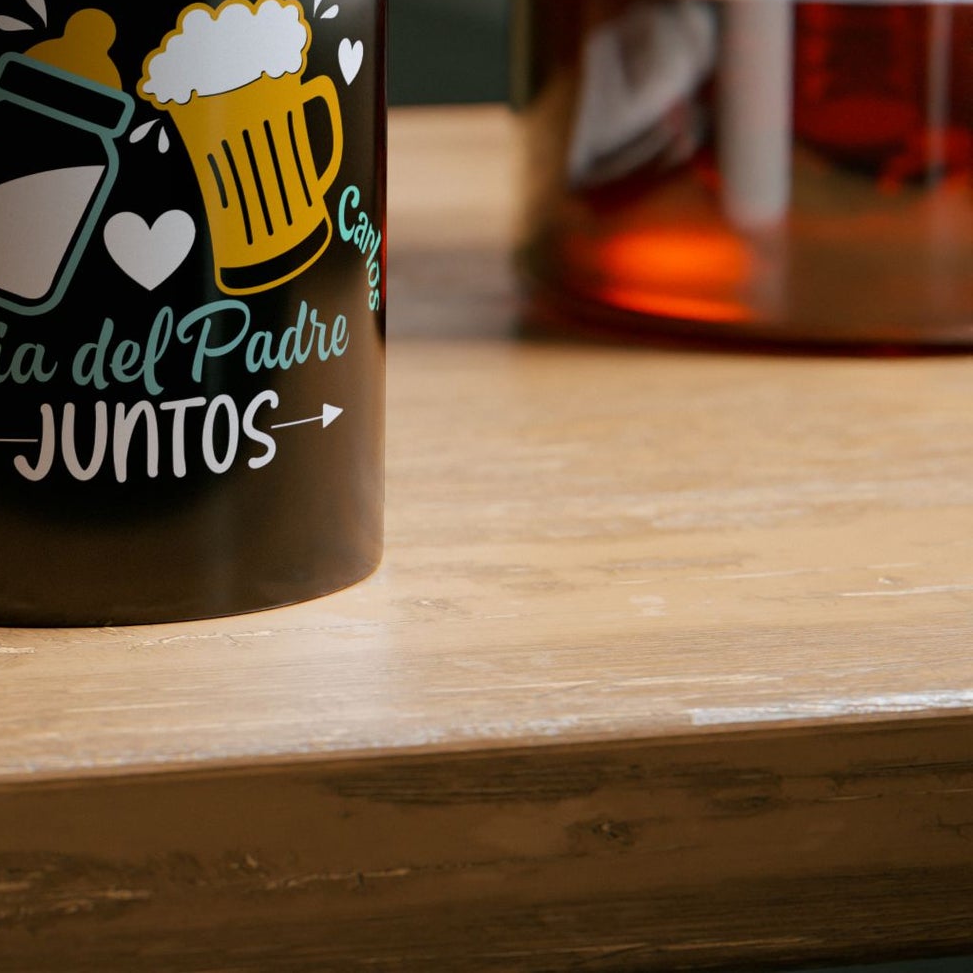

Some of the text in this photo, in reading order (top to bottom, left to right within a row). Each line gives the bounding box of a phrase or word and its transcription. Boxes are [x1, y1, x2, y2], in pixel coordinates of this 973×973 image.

[338, 184, 382, 312] Carlos
[71, 305, 175, 396] del
[175, 299, 350, 383] Padre
[13, 389, 279, 483] JUNTOS
